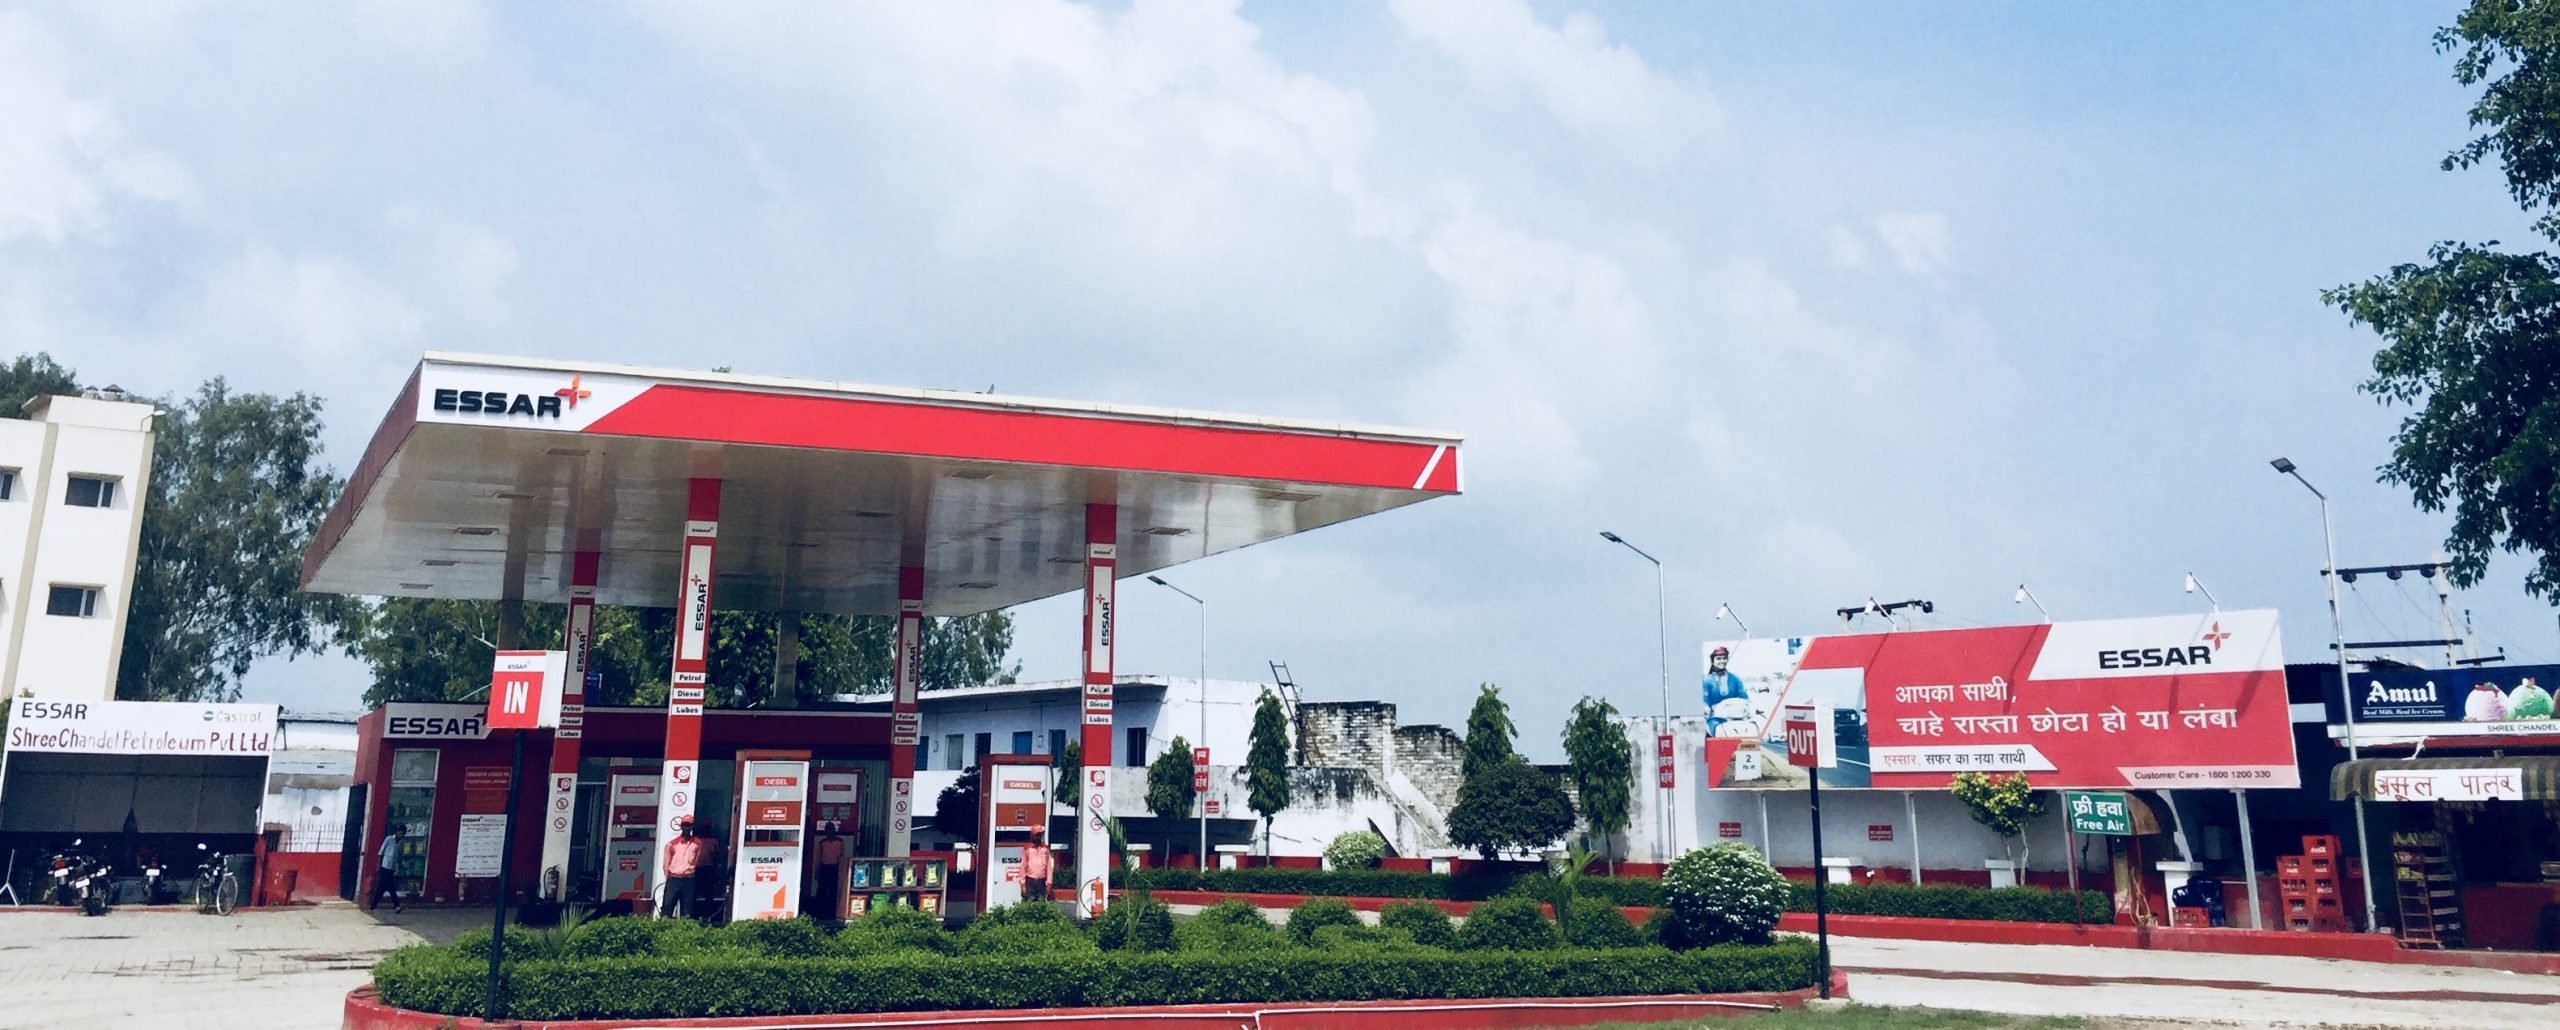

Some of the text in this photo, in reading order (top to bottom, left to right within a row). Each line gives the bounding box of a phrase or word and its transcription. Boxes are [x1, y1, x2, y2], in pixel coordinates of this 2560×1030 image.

[434, 389, 561, 417] ESSAR
[695, 584, 707, 631] ESSAR
[1101, 601, 1110, 647] ESSAR
[576, 634, 587, 673] ESSAR
[908, 646, 916, 682] ESSAR
[2098, 646, 2212, 669] ESSAR
[678, 673, 703, 682] Petrol
[503, 681, 529, 713] IN
[676, 690, 702, 698] Diesel
[1895, 676, 2018, 705] आपका साथी,
[2366, 680, 2437, 705] Amul
[22, 703, 87, 720] ESSAR
[675, 706, 700, 714] Lubes
[1896, 703, 2238, 737] चाहे रास्ता छोटा हो या लंबा
[389, 717, 480, 735] ESSAR
[11, 727, 57, 747] Shree
[58, 728, 119, 749] Chandel
[122, 730, 206, 751] Petroleum
[1789, 728, 1815, 756] OUT
[1746, 754, 1751, 763] 2
[1924, 754, 1951, 765] सफर
[1954, 754, 1969, 765] का
[1973, 754, 1994, 764] नया
[1998, 748, 2026, 765] साथी
[2134, 771, 2176, 779] Customer
[2178, 771, 2200, 779] Care
[2254, 770, 2271, 778] 330
[2095, 802, 2123, 817] हवा
[2076, 818, 2124, 831] Free Air
